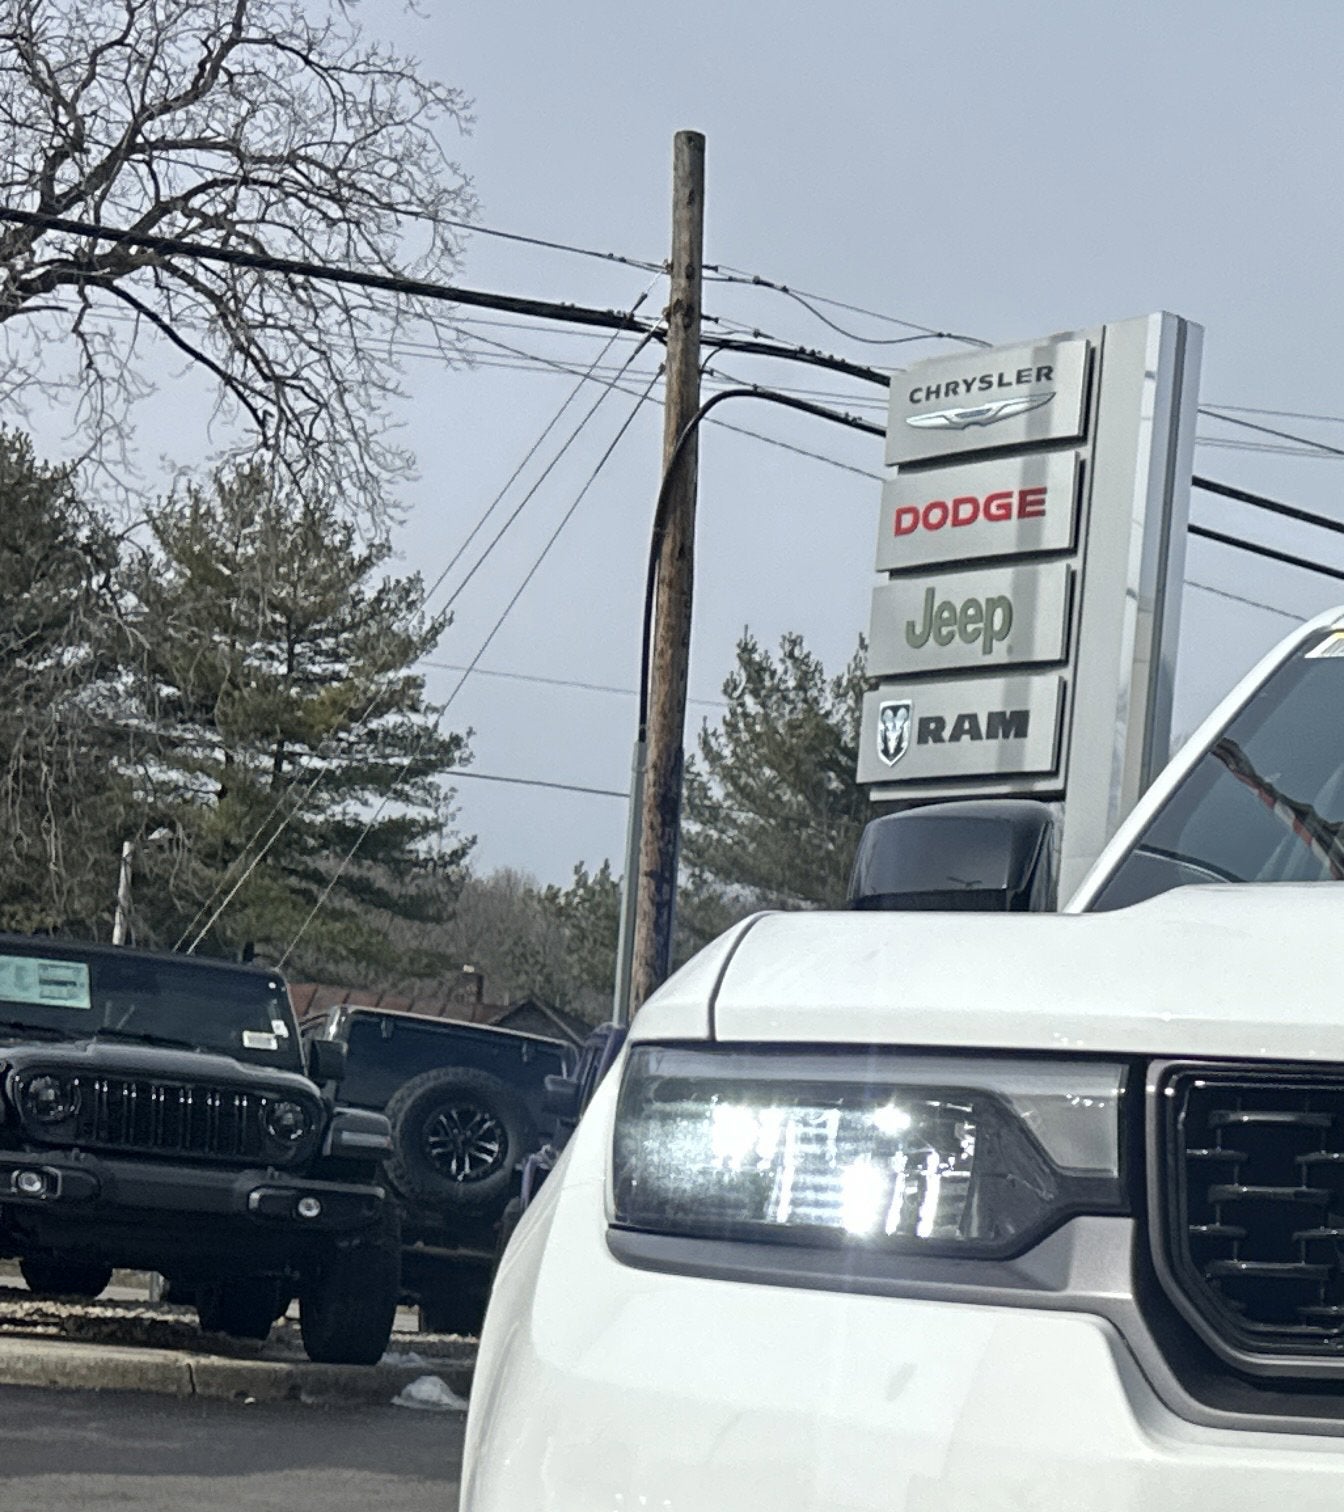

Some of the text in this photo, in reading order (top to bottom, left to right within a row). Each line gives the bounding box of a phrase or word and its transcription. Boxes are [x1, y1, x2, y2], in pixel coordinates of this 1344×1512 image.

[909, 365, 1055, 403] CHRYSLER
[894, 487, 1047, 537] DODGE
[905, 587, 1013, 655] Jeep
[917, 710, 1030, 745] RAM
